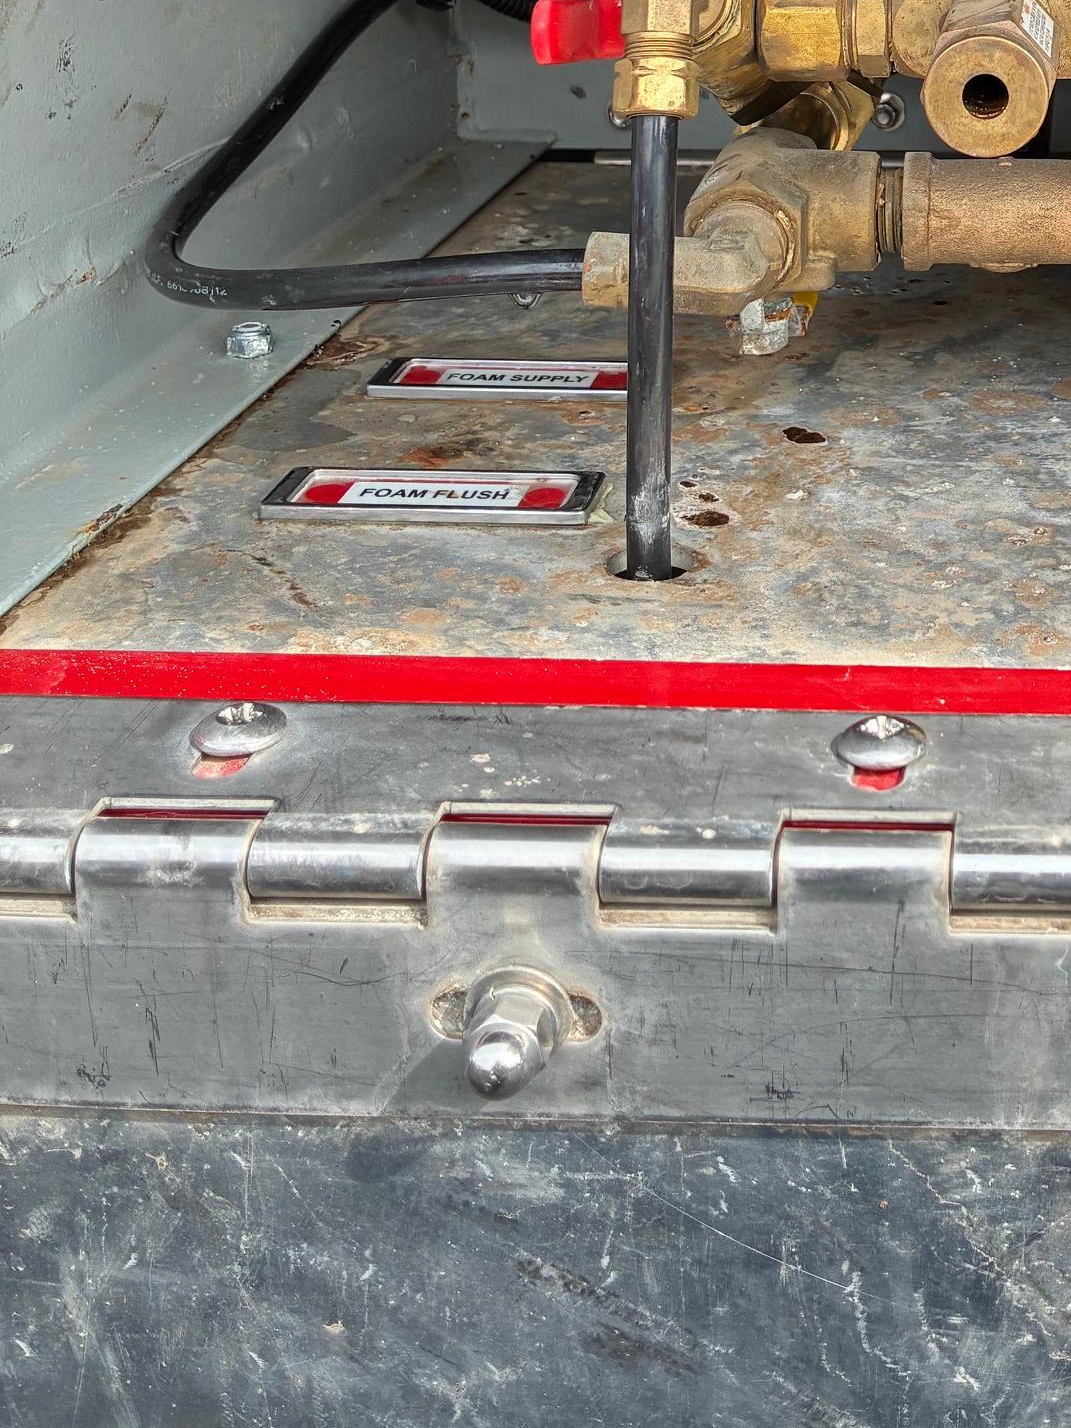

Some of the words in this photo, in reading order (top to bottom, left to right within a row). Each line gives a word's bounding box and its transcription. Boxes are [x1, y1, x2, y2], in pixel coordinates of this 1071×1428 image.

[447, 373, 504, 382] FOAM
[510, 374, 589, 383] SUPPLY
[359, 488, 428, 499] FOAM
[432, 488, 510, 500] FLUSH
